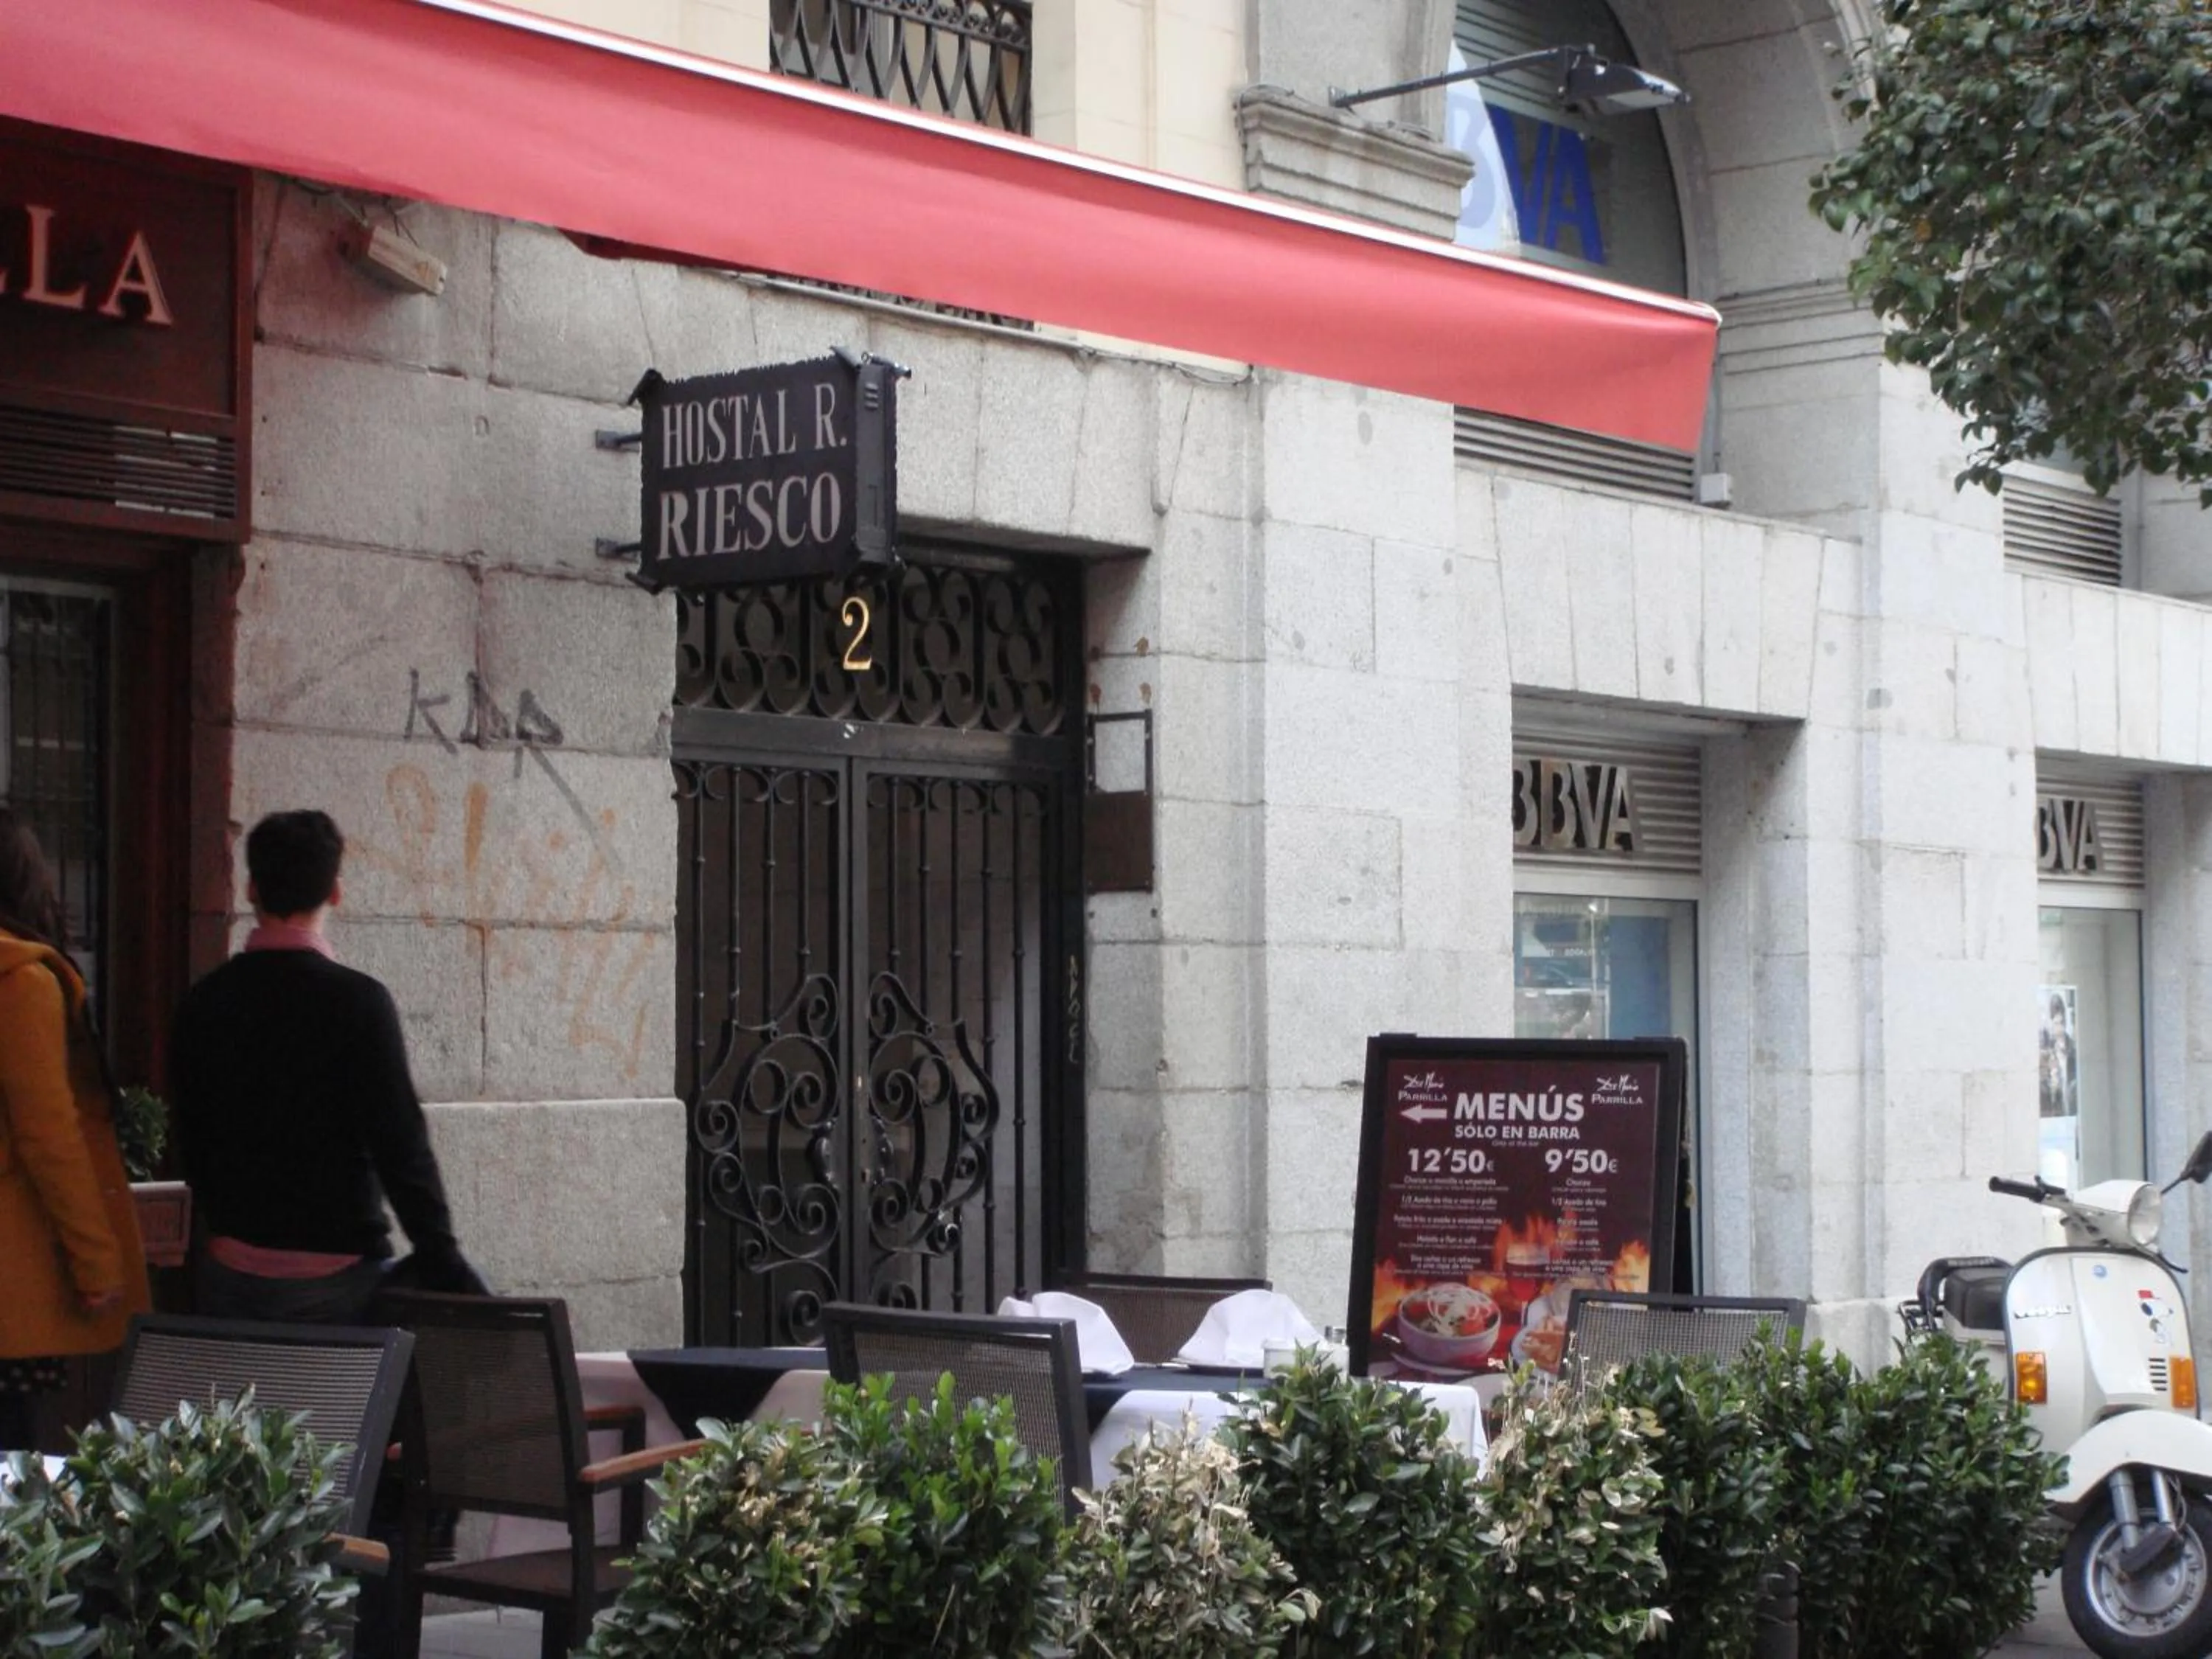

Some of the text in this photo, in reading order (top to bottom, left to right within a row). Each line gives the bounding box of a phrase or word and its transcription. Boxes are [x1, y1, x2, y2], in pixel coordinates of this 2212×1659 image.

[0, 203, 173, 325] LA
[661, 382, 847, 469] HOSTAL R.
[656, 472, 841, 561] RIESCO
[841, 596, 872, 670] 2
[1512, 757, 1644, 854] BBVA
[1454, 1085, 1585, 1121] MENÚS
[1454, 1122, 1580, 1140] SÓLO EN BARRA
